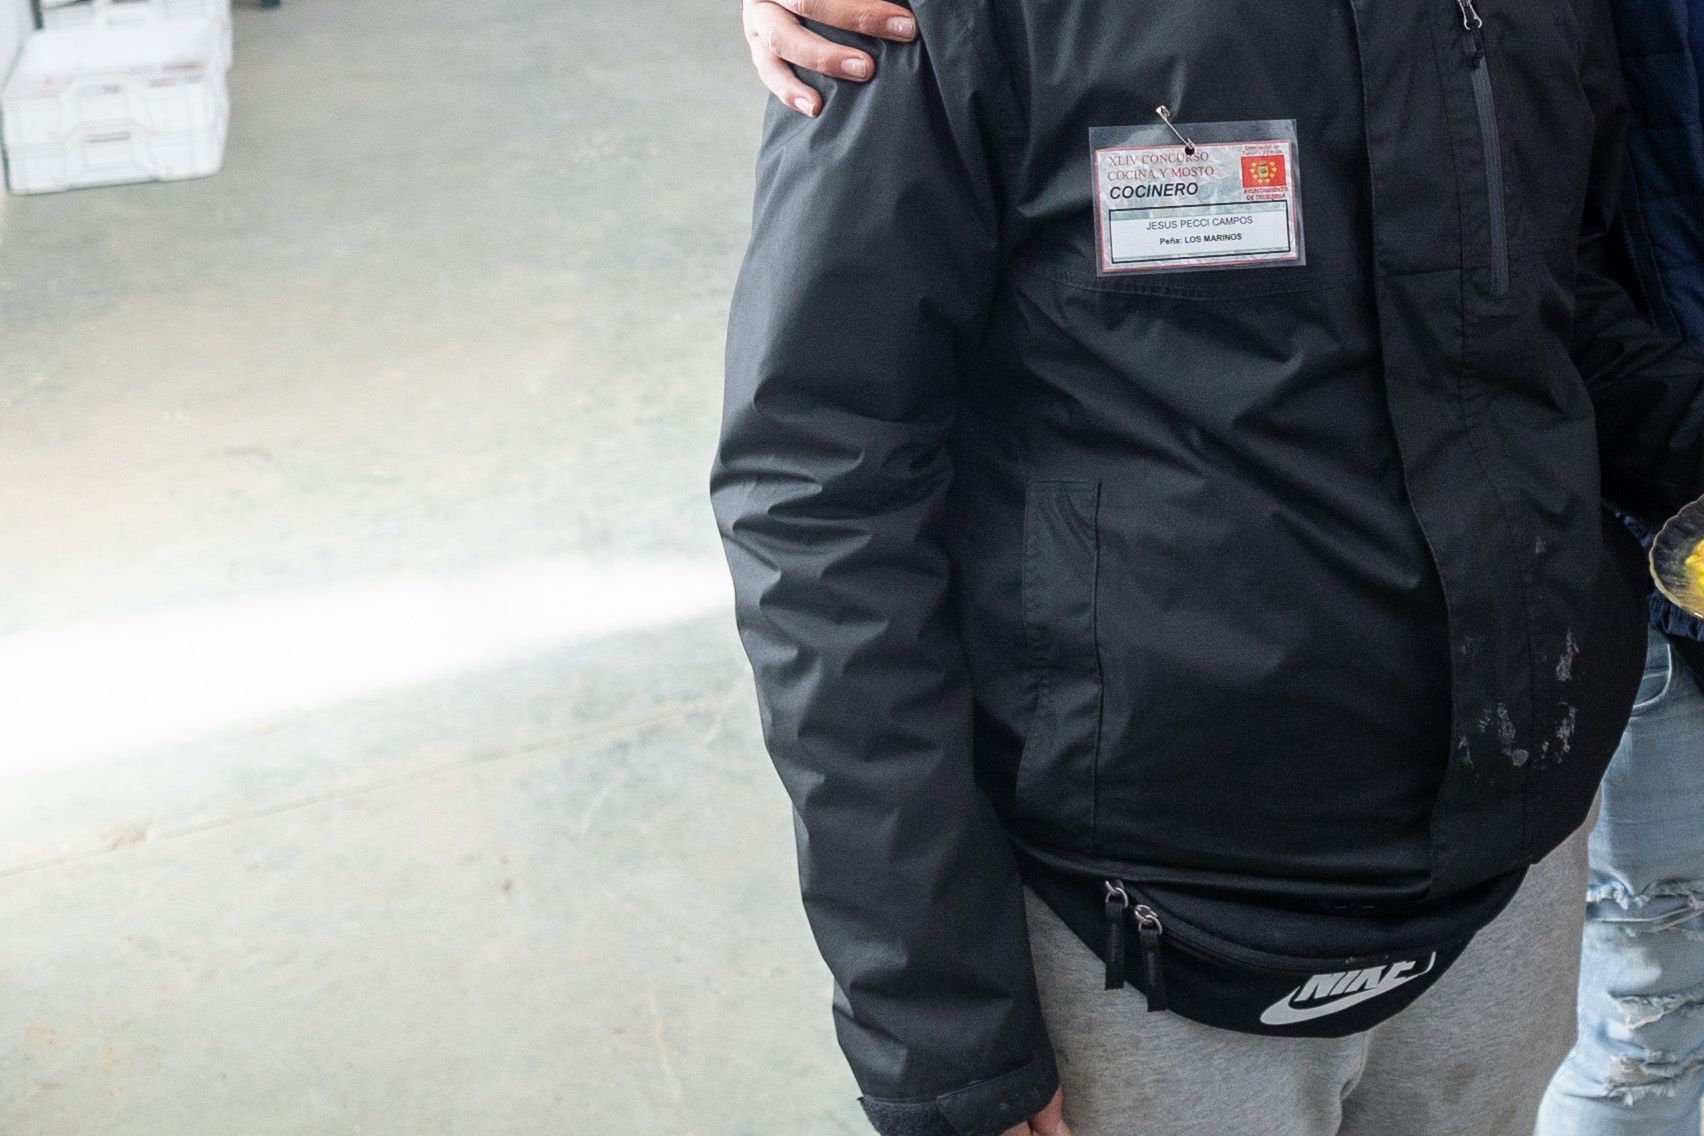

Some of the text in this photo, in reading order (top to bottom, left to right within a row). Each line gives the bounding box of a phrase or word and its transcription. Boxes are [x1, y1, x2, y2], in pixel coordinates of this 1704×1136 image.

[1141, 151, 1209, 164] CONCURSO
[1107, 166, 1214, 181] COCINA Y MOSTO
[1109, 182, 1199, 200] COCINERO
[1146, 220, 1178, 231] JESUS
[1211, 215, 1254, 226] CAMPOS
[1184, 235, 1202, 244] LOS
[1203, 232, 1243, 242] MARINOS
